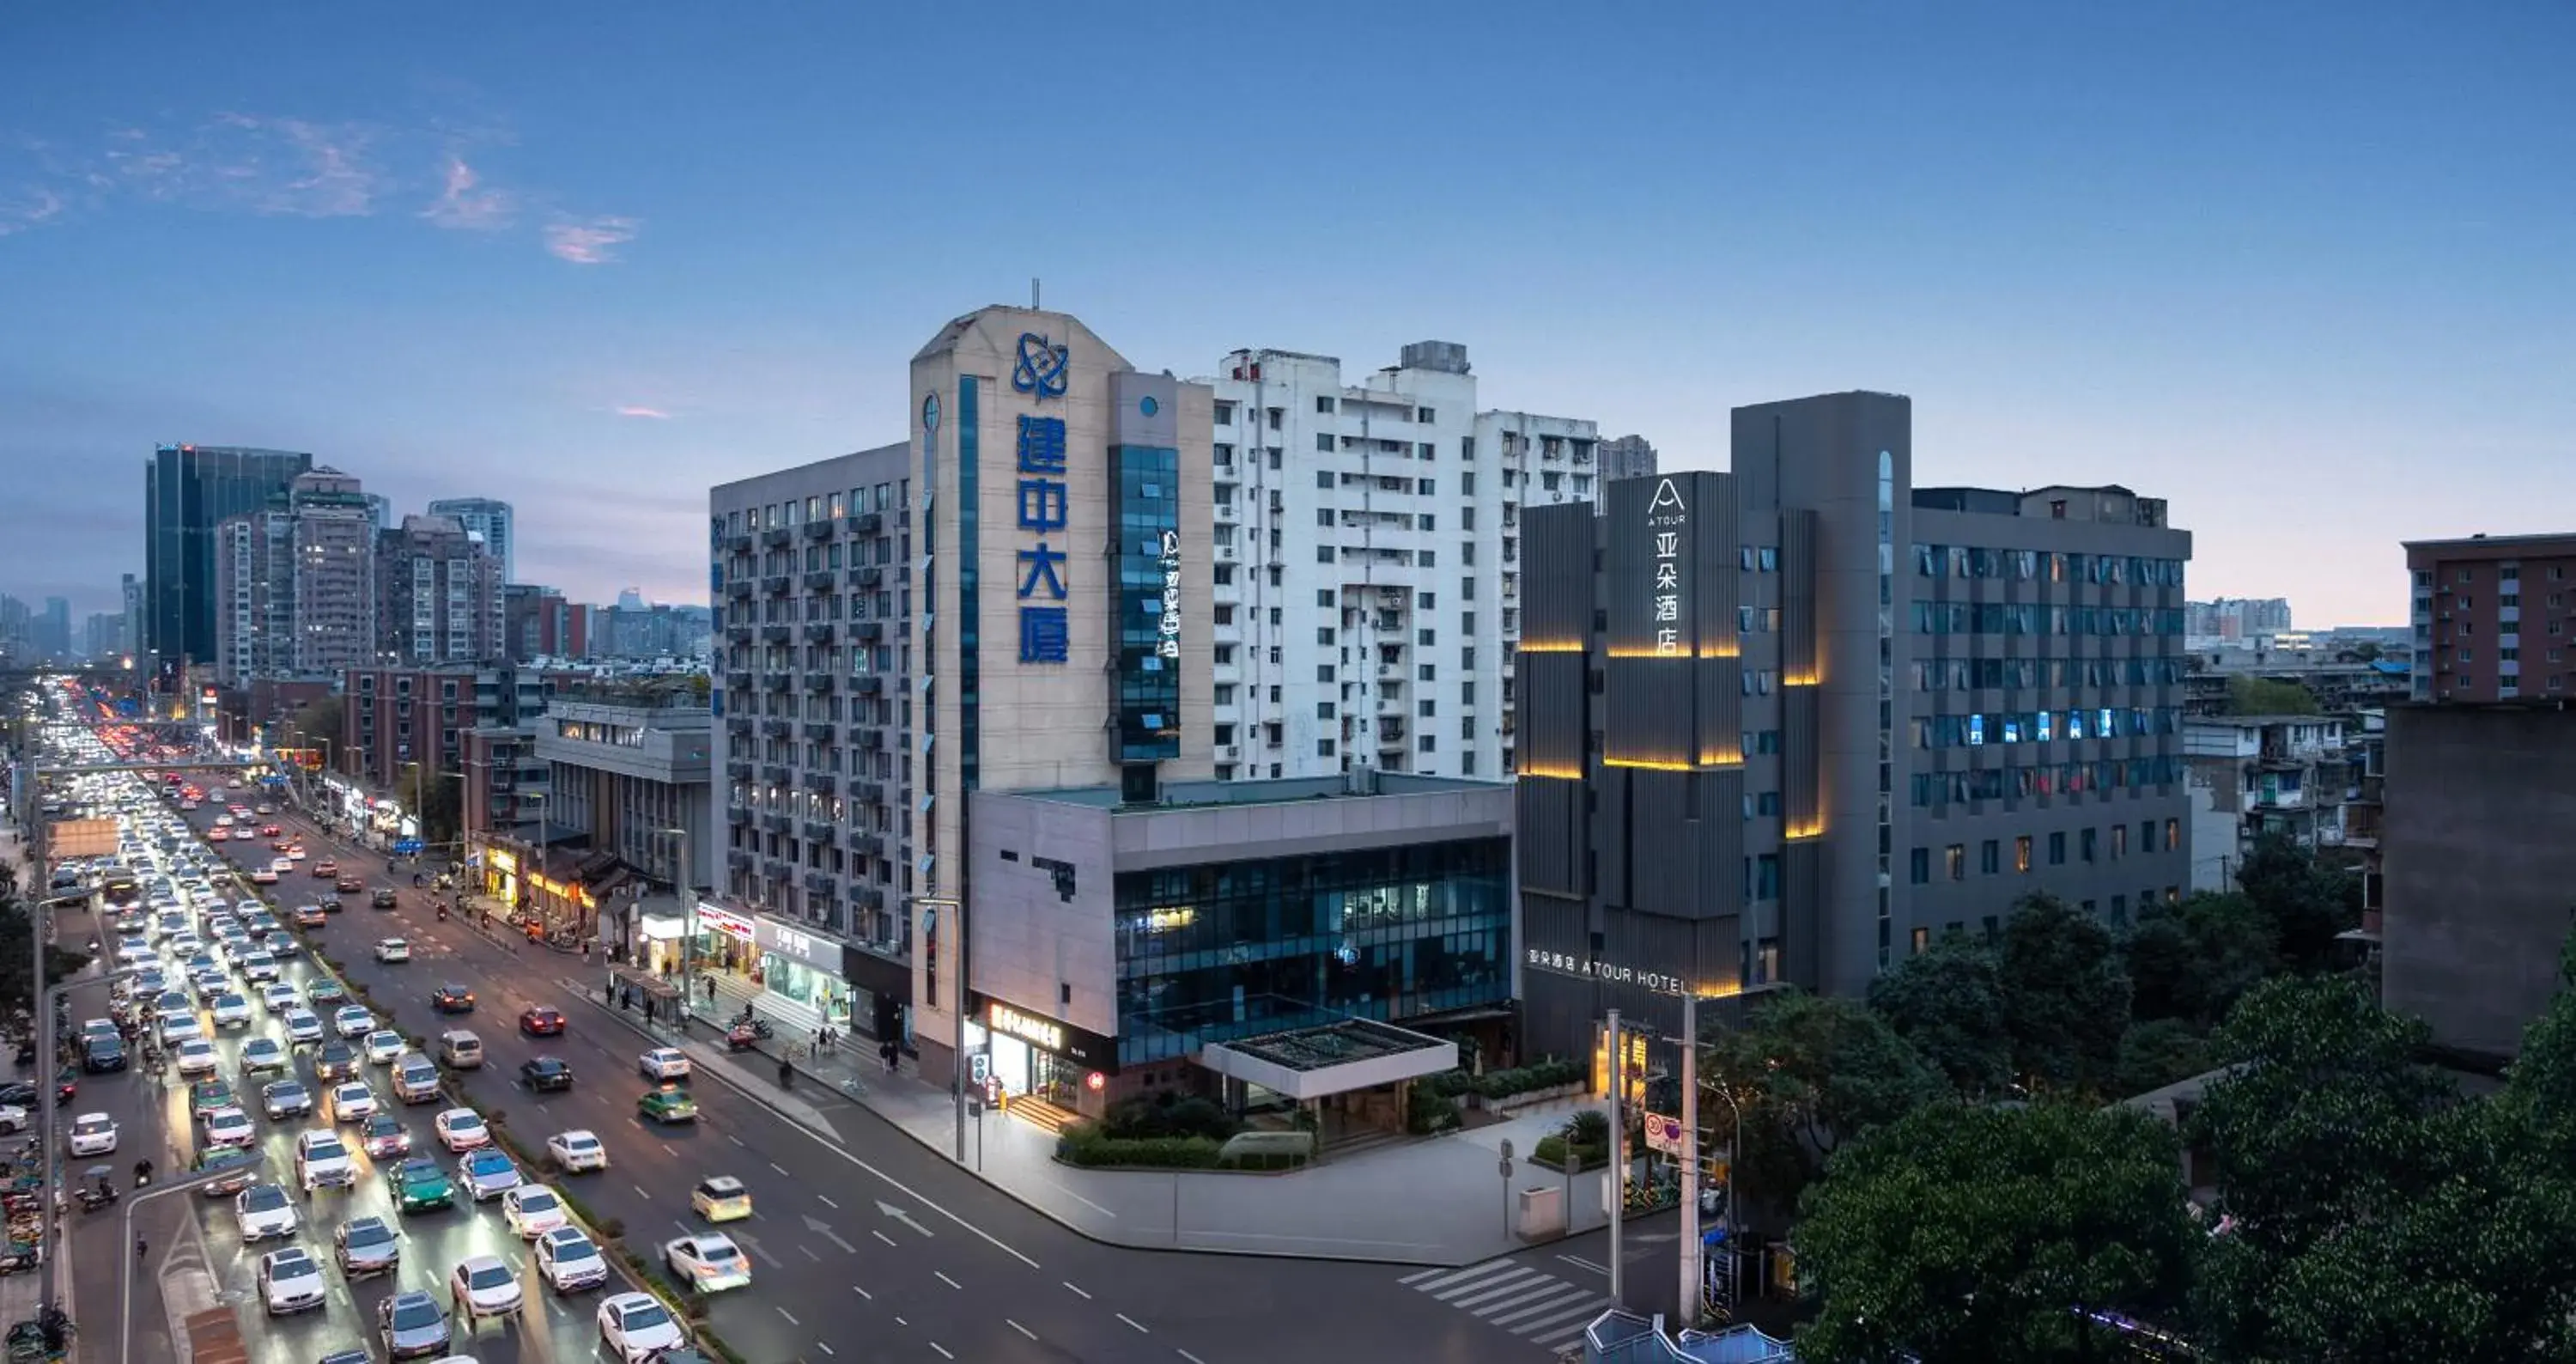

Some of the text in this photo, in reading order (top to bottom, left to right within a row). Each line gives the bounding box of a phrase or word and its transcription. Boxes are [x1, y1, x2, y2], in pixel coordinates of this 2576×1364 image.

[1017, 413, 1067, 663] 建中大厦
[1648, 515, 1686, 527] ATOUR
[1656, 532, 1677, 655] 亚朵酒店
[1583, 960, 1631, 983] ATOUR
